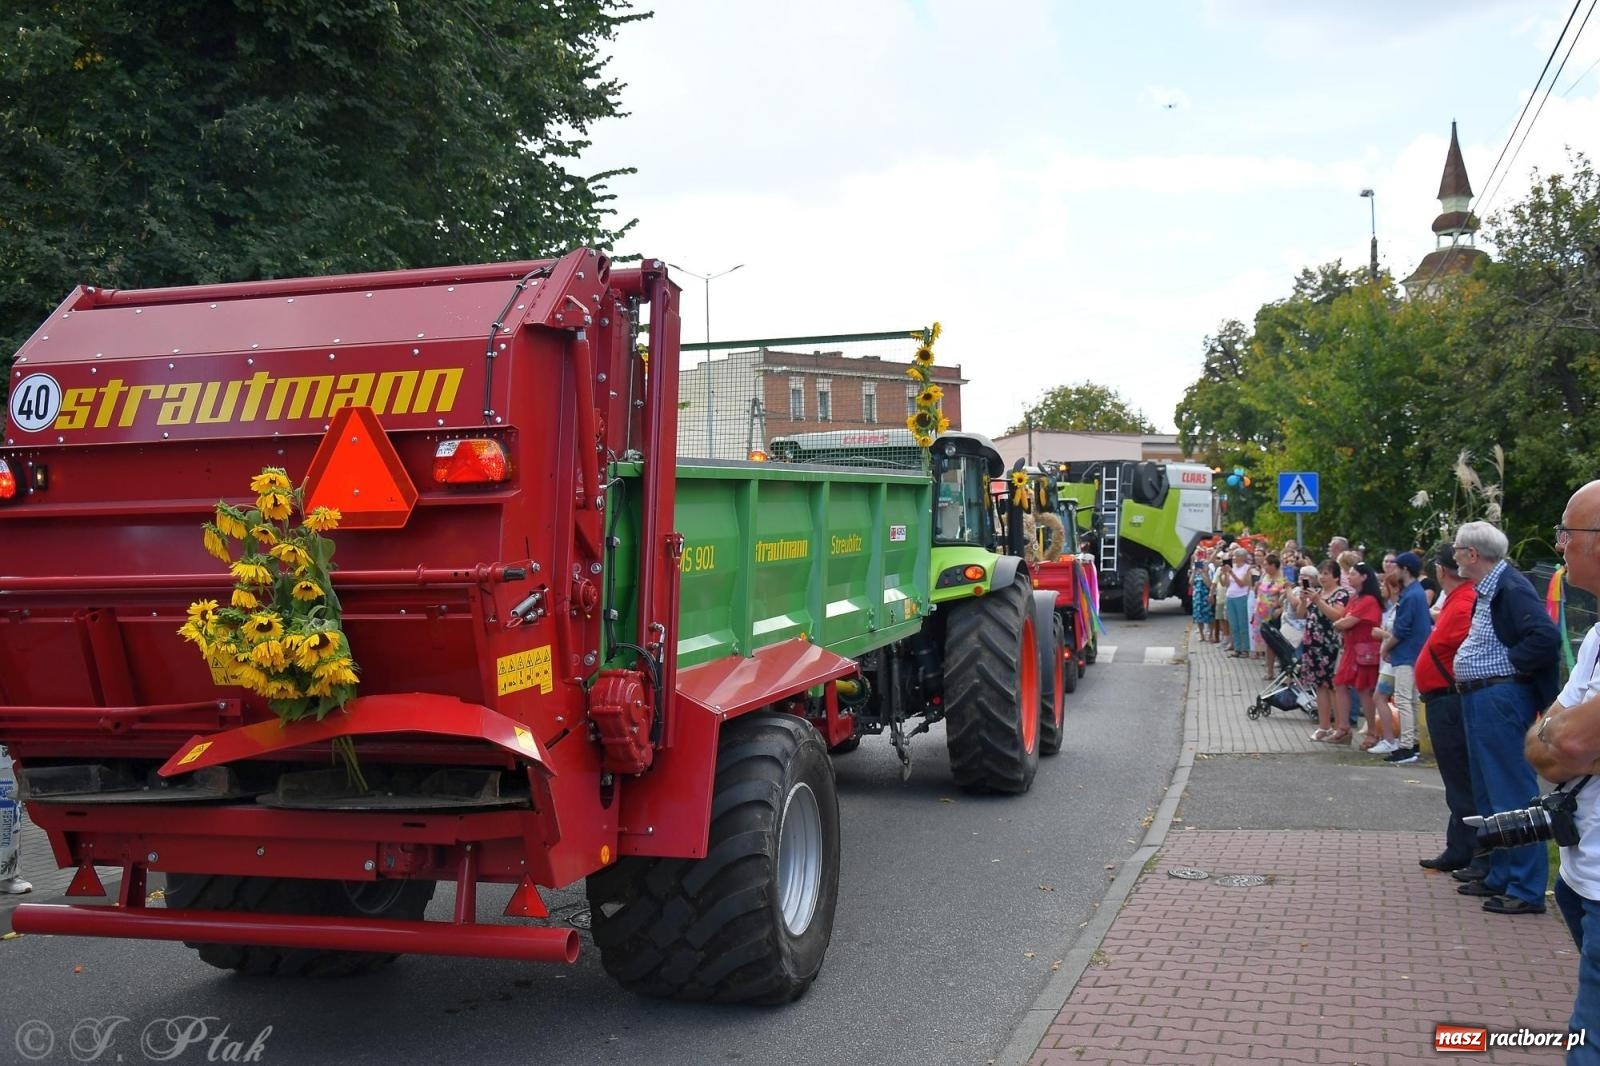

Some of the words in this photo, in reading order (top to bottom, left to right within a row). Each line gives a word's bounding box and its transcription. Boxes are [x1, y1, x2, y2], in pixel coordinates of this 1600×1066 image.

[17, 384, 50, 421] 40
[54, 367, 464, 431] strautmann
[1182, 472, 1207, 484] CLAAS
[695, 545, 715, 571] 901
